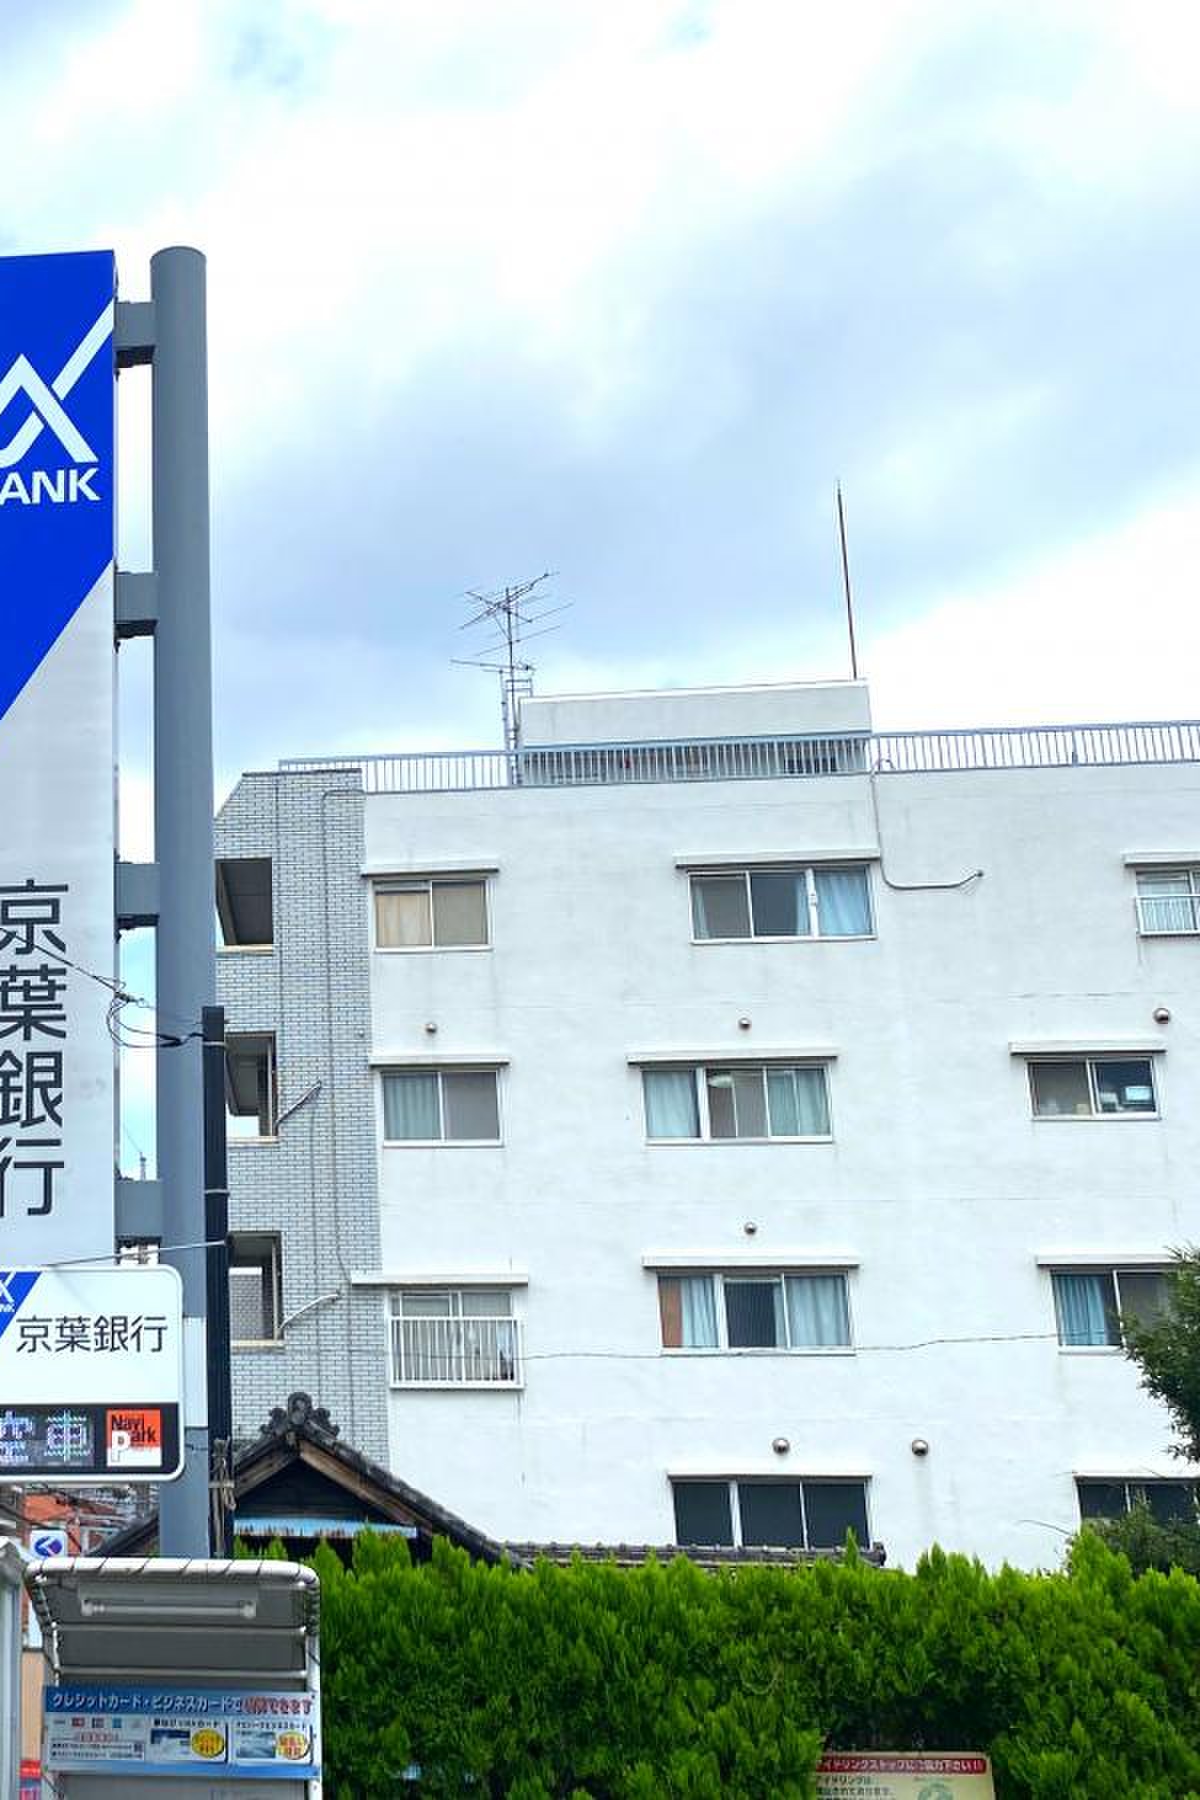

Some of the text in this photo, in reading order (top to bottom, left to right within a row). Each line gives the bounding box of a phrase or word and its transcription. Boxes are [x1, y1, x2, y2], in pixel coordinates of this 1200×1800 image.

[15, 1315, 168, 1353] 京葉銀行
[111, 1414, 145, 1431] Navi
